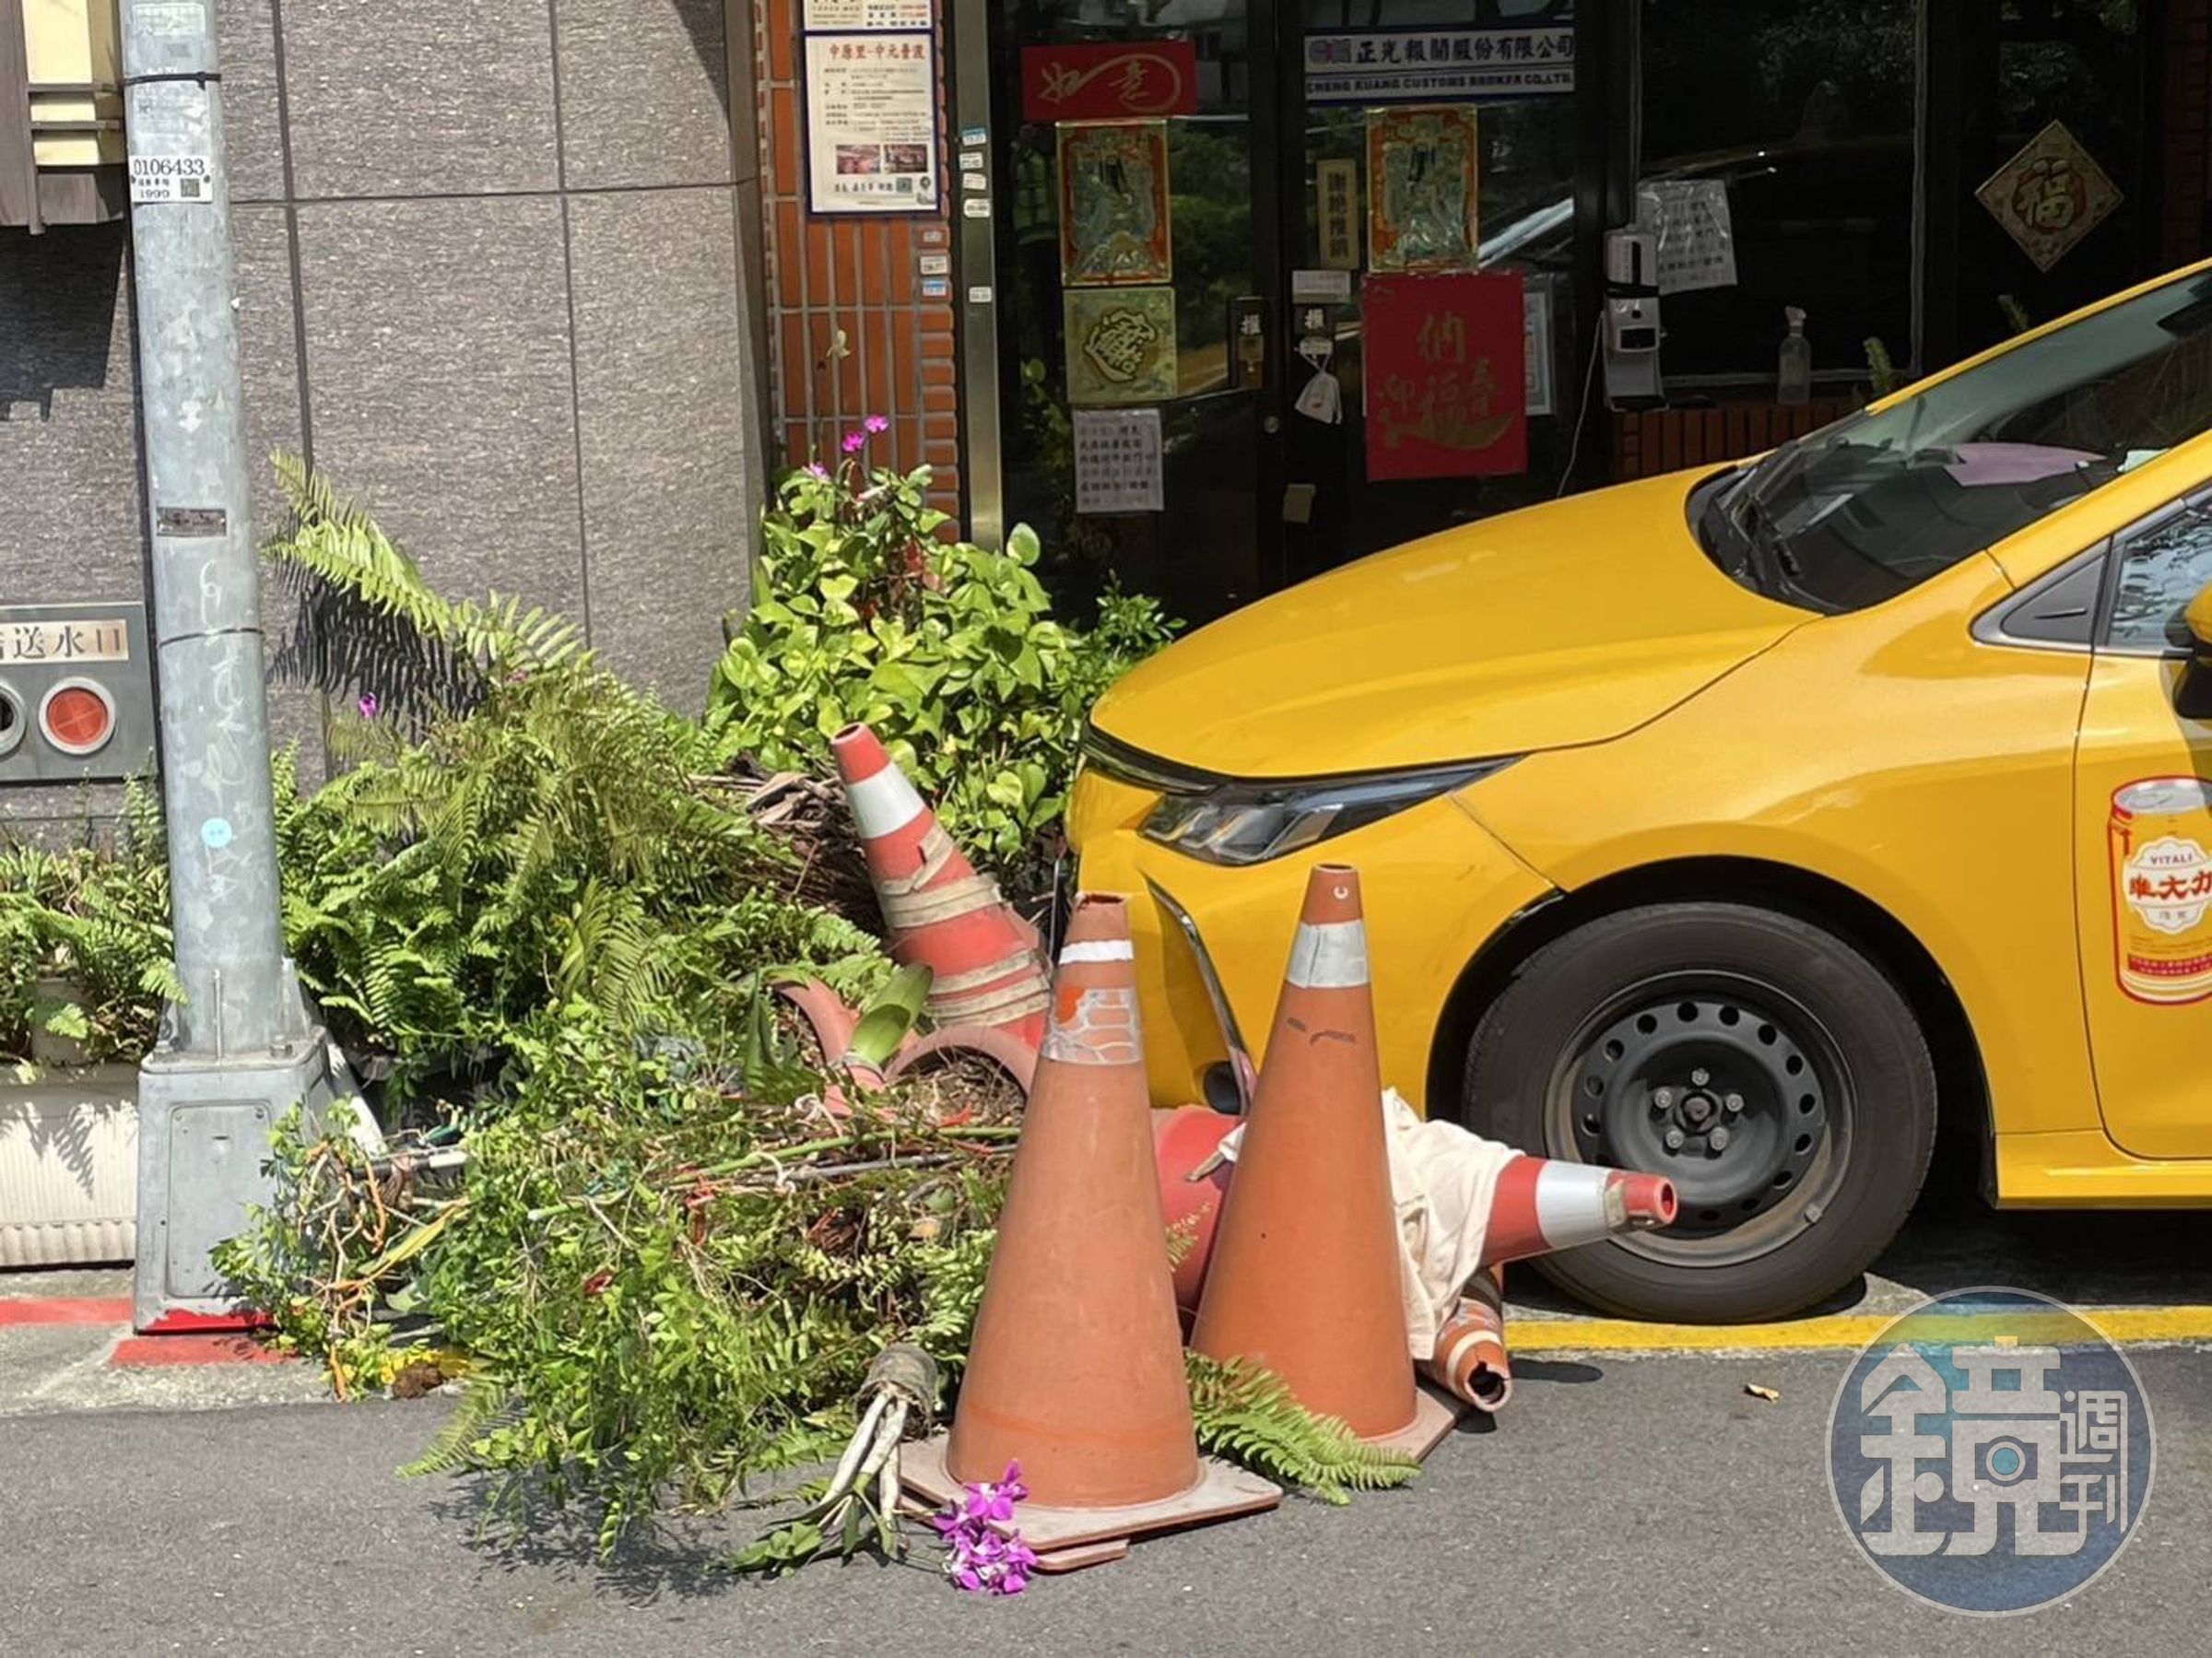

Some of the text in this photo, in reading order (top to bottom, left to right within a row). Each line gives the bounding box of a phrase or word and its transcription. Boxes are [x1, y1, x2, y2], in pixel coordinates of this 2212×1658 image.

[1356, 35, 1574, 65] 正光報關股份有限公司
[1306, 79, 1351, 94] CHENG
[1354, 77, 1403, 92] KUANG
[1403, 76, 1466, 89] CUSTOMS
[133, 158, 206, 176] 0106433
[2014, 158, 2076, 229] 福
